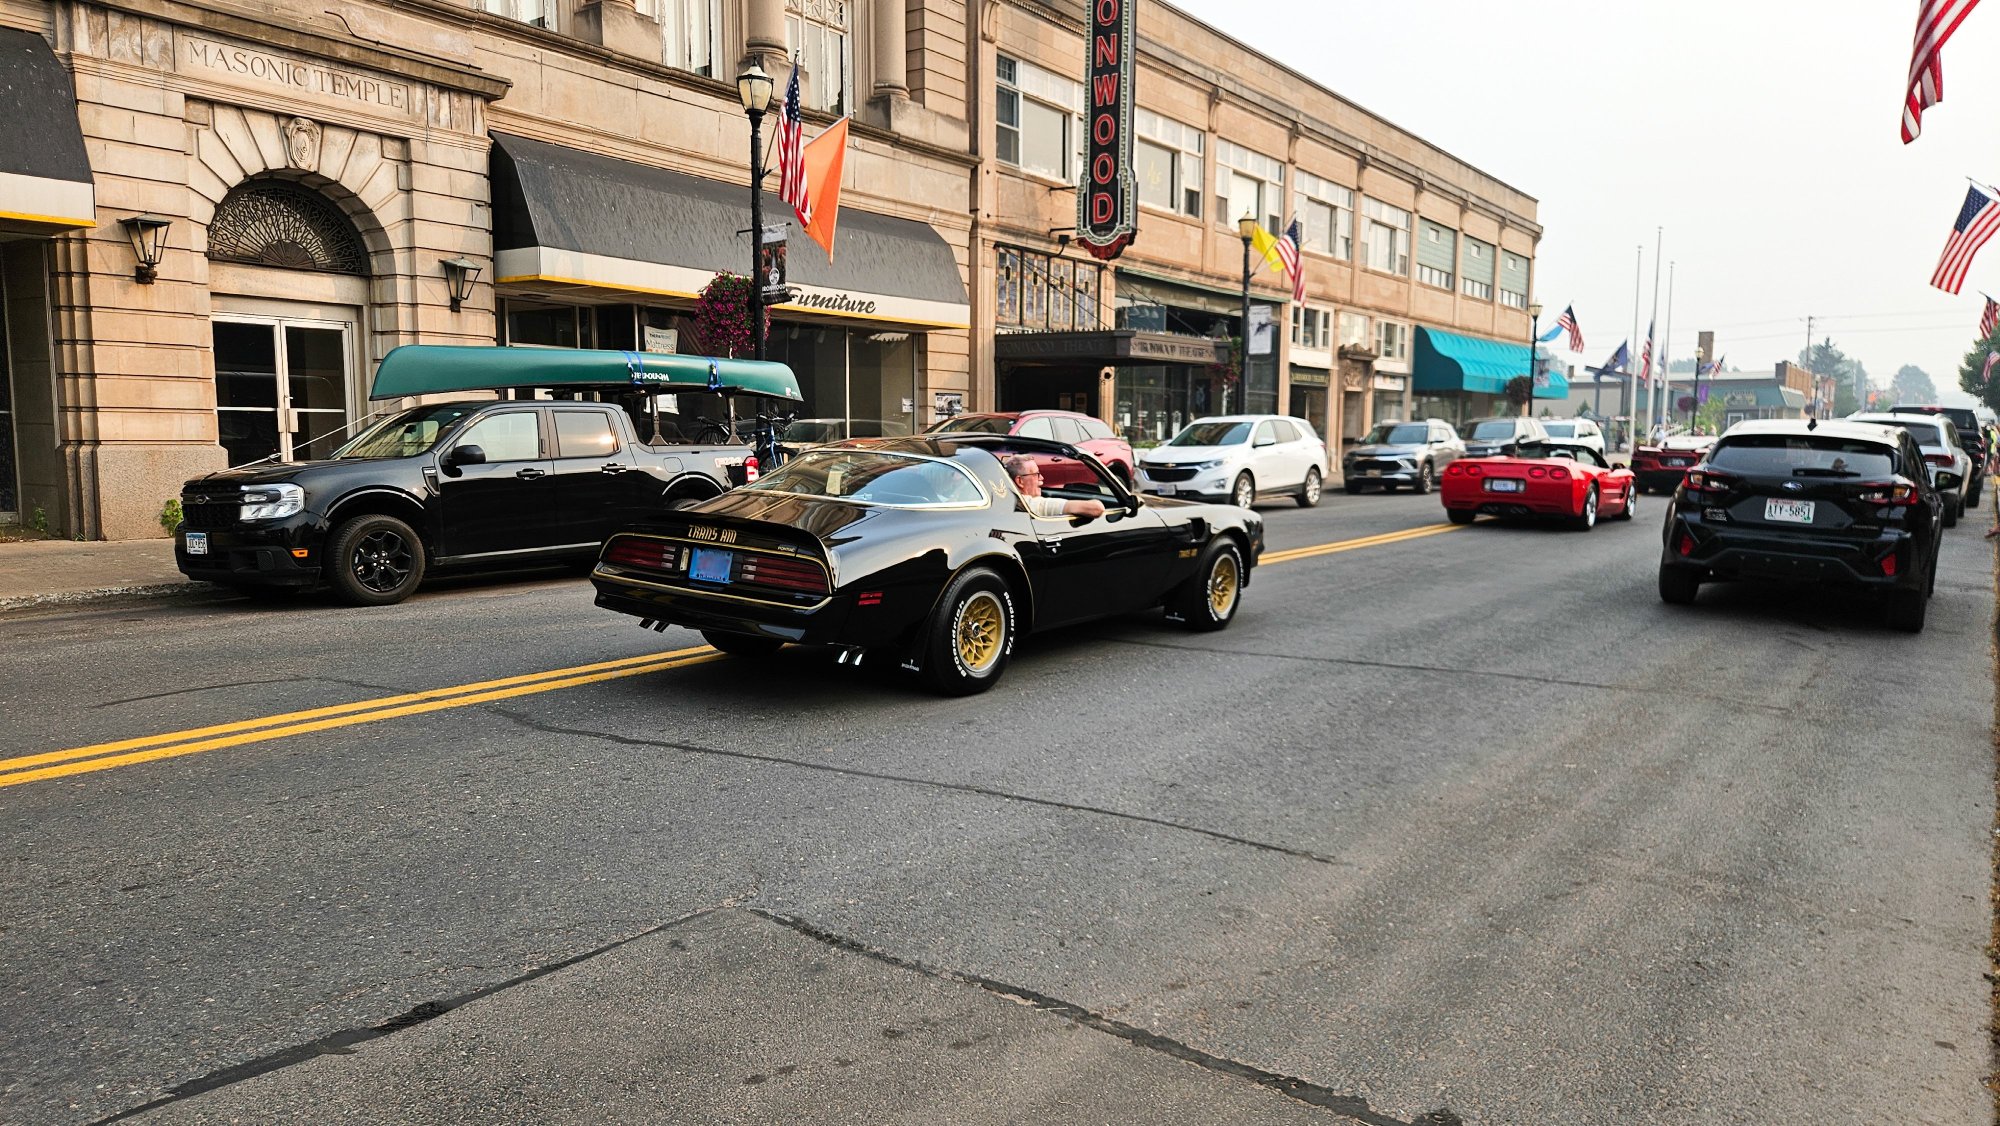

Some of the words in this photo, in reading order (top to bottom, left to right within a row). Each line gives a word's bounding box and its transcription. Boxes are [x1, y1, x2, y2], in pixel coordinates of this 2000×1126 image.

[189, 41, 307, 87] MASONIC
[313, 69, 403, 109] TEMPLE
[786, 285, 876, 314] Furniture
[688, 524, 718, 541] TRANS
[720, 528, 737, 543] AM
[777, 545, 796, 553] PONTIAC
